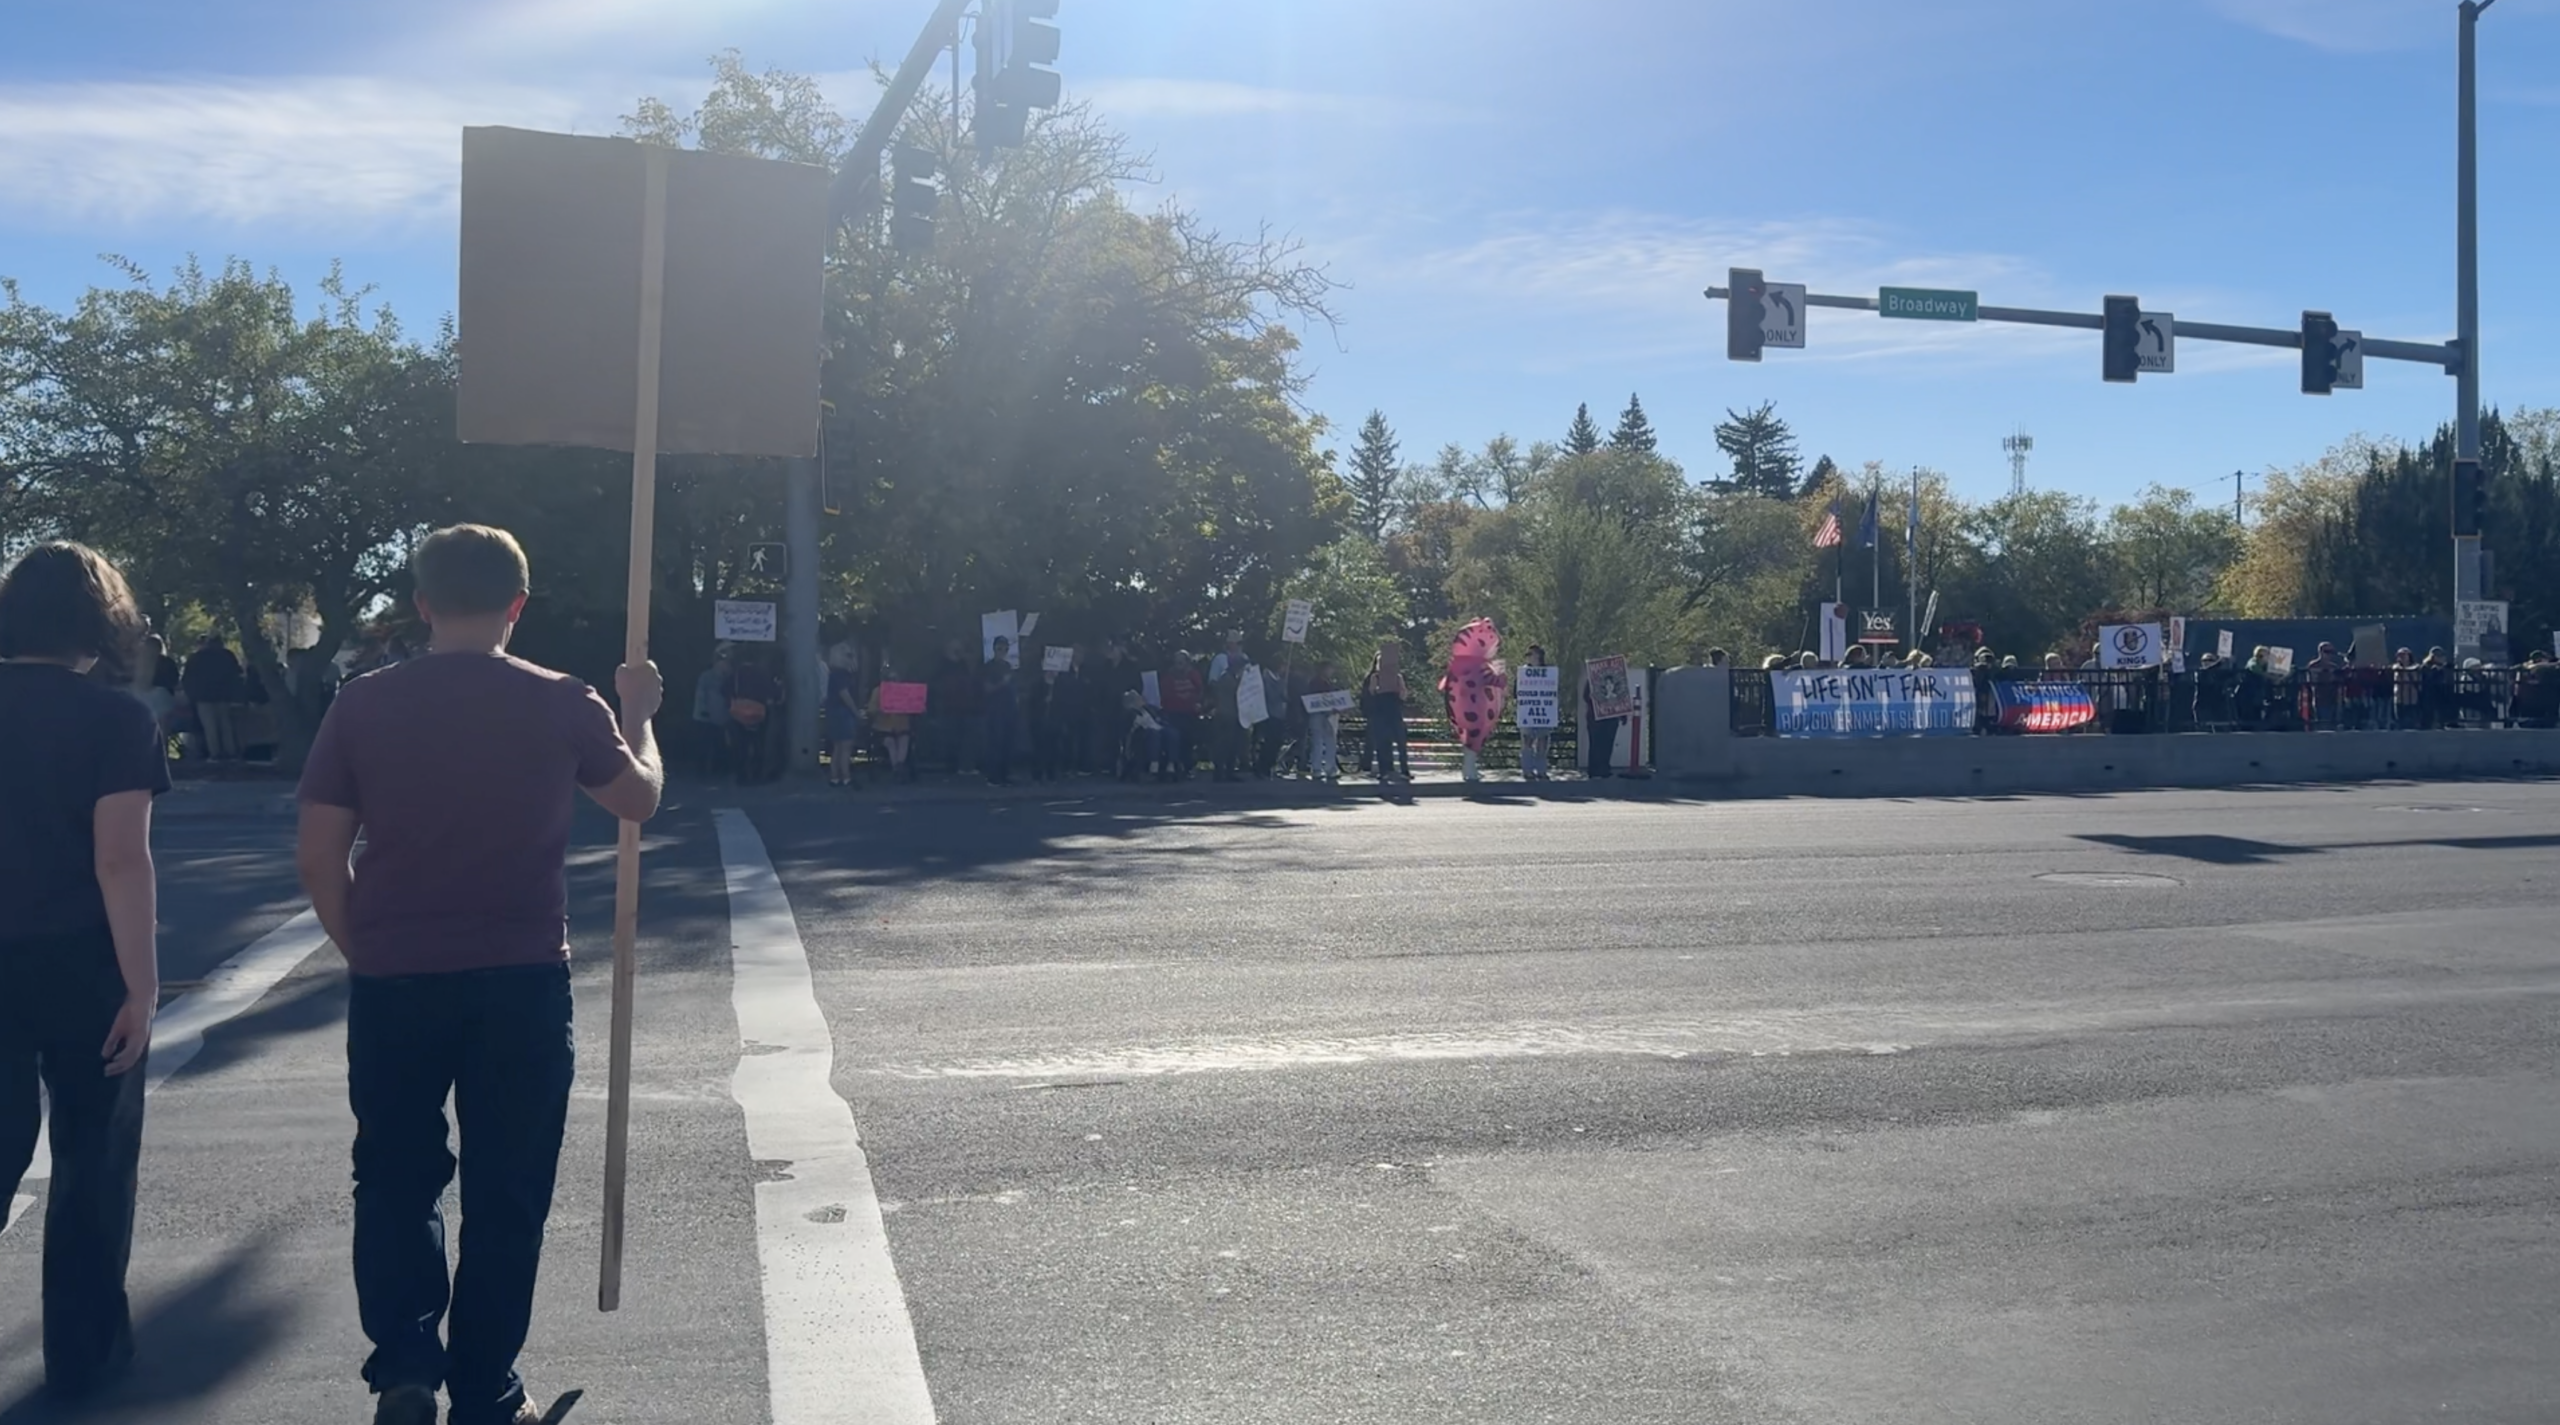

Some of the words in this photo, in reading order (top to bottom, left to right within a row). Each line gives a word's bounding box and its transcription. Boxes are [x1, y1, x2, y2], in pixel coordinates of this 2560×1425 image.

[1889, 294, 1967, 317] Broadway
[1766, 329, 1797, 342] ONLY
[2140, 354, 2167, 368] ONLY
[2337, 372, 2356, 384] NLY
[2117, 656, 2147, 665] KINGS
[1525, 668, 1548, 678] ONE
[1801, 674, 1841, 702] LIFE
[1846, 674, 1897, 701] ISN'T
[1900, 673, 1947, 702] FAIR,
[2011, 685, 2036, 703] NO
[2038, 684, 2082, 697] KINGS
[1528, 707, 1547, 716] ALL
[2046, 700, 2060, 712] IN
[1781, 711, 1808, 731] BUT
[1811, 710, 1896, 732] GOVERNMENT
[1899, 709, 1949, 730] SHOULD
[2014, 711, 2088, 728] AMERICA
